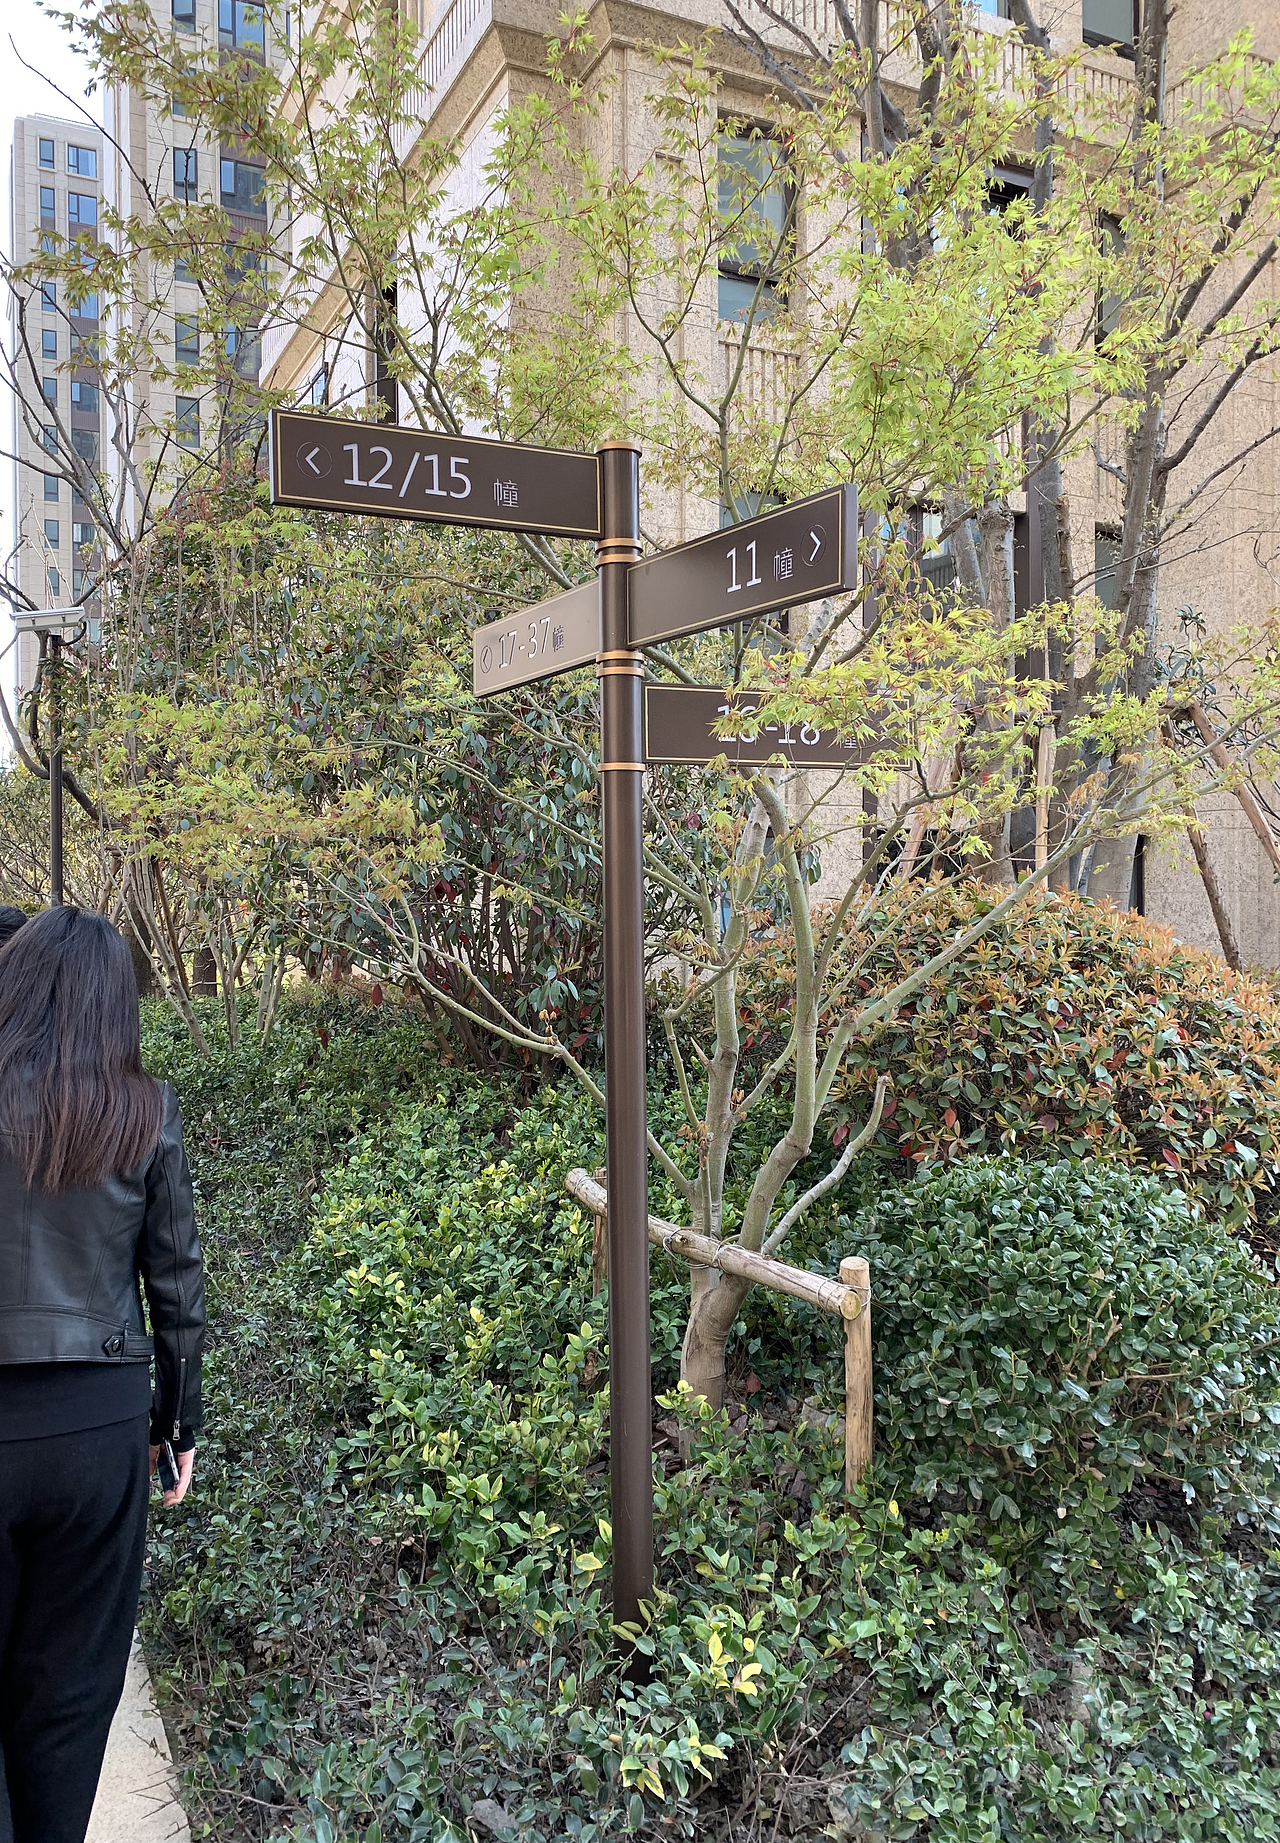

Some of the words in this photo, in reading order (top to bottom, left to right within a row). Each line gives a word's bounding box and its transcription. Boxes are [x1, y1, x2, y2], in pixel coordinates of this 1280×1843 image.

[342, 442, 472, 499] 12/15
[493, 478, 519, 508] 幢
[725, 539, 762, 593] 11
[773, 547, 794, 582] 幢
[498, 616, 551, 669] 17-37
